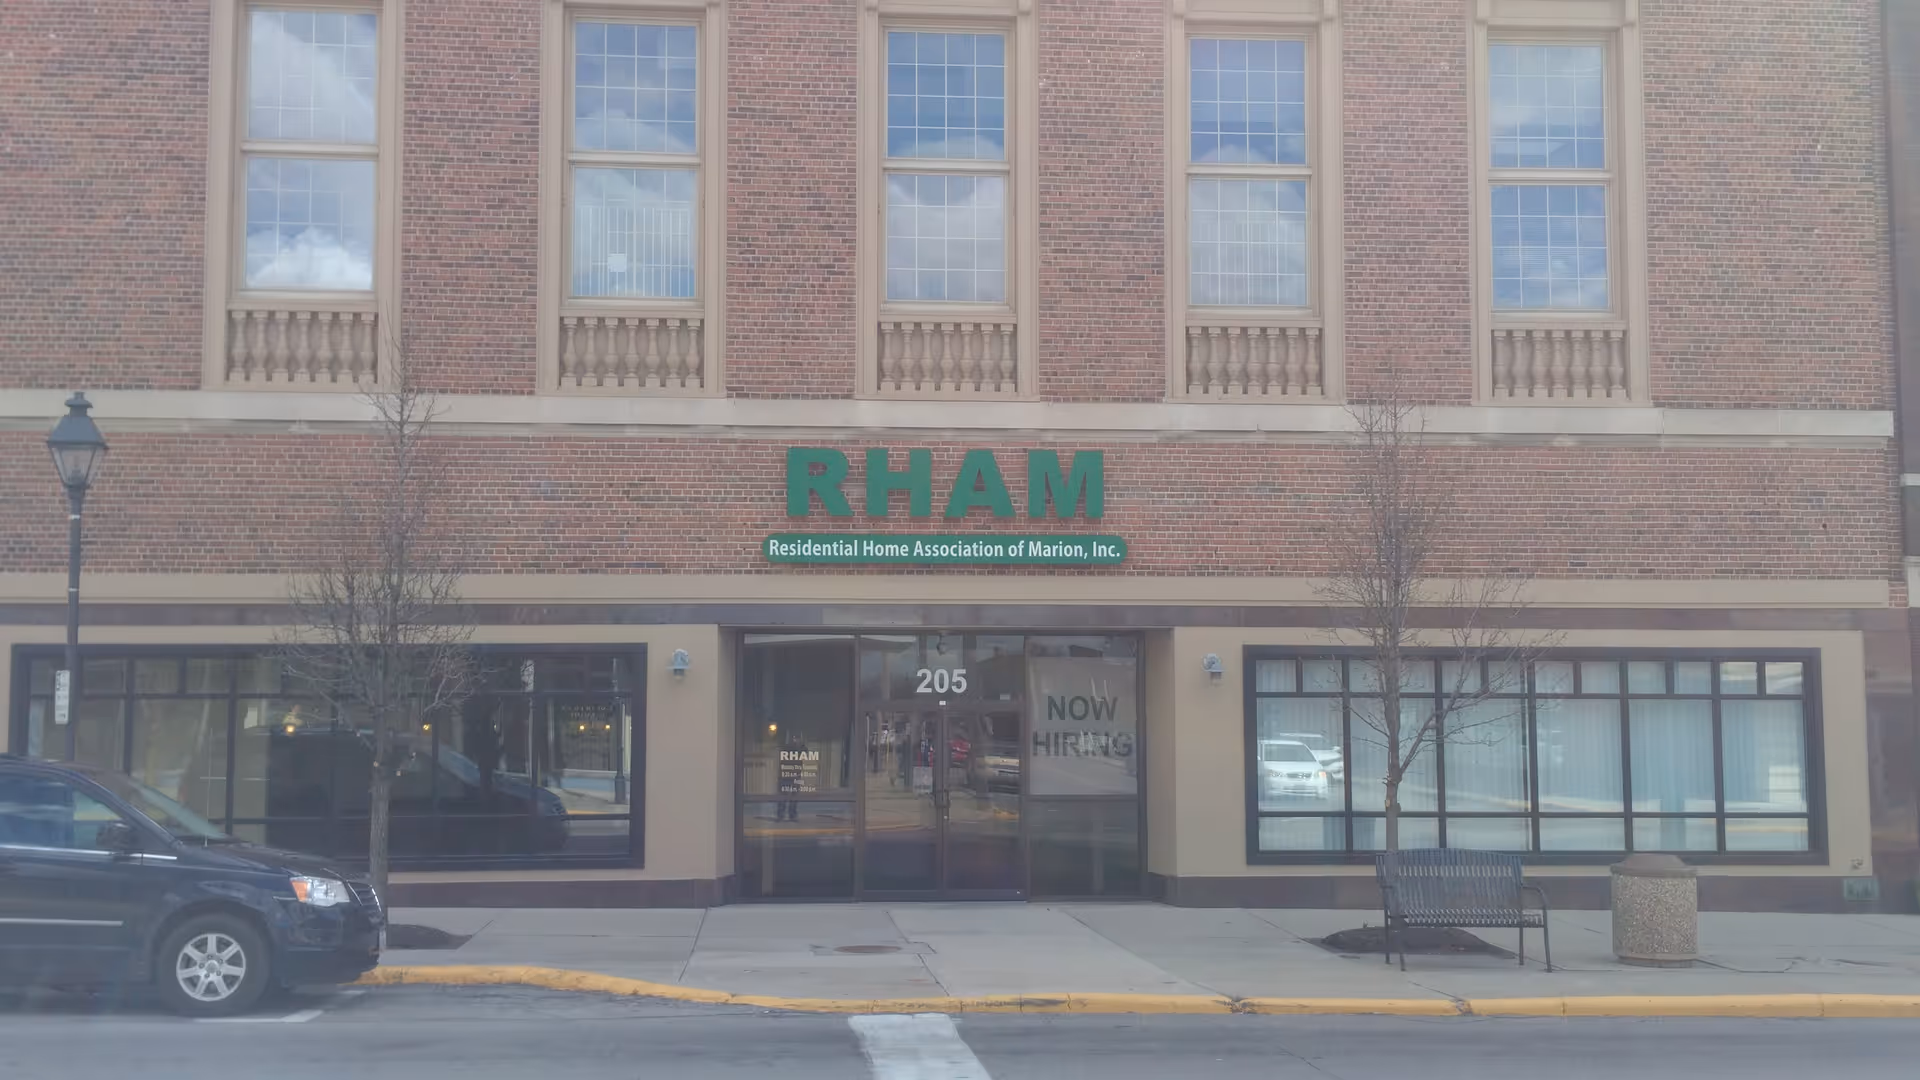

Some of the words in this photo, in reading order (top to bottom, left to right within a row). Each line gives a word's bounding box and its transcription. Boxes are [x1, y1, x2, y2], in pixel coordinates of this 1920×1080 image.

[786, 446, 1104, 518] RHAM
[769, 539, 858, 557] Residential
[863, 540, 909, 557] Home
[913, 540, 1004, 558] Association
[1008, 540, 1025, 558] of
[1028, 540, 1088, 560] Marion,
[1092, 541, 1121, 558] Inc.
[916, 668, 967, 693] 205
[1047, 695, 1118, 721] NOW
[780, 751, 819, 761] RHAM
[1032, 730, 1133, 757] HIRING
